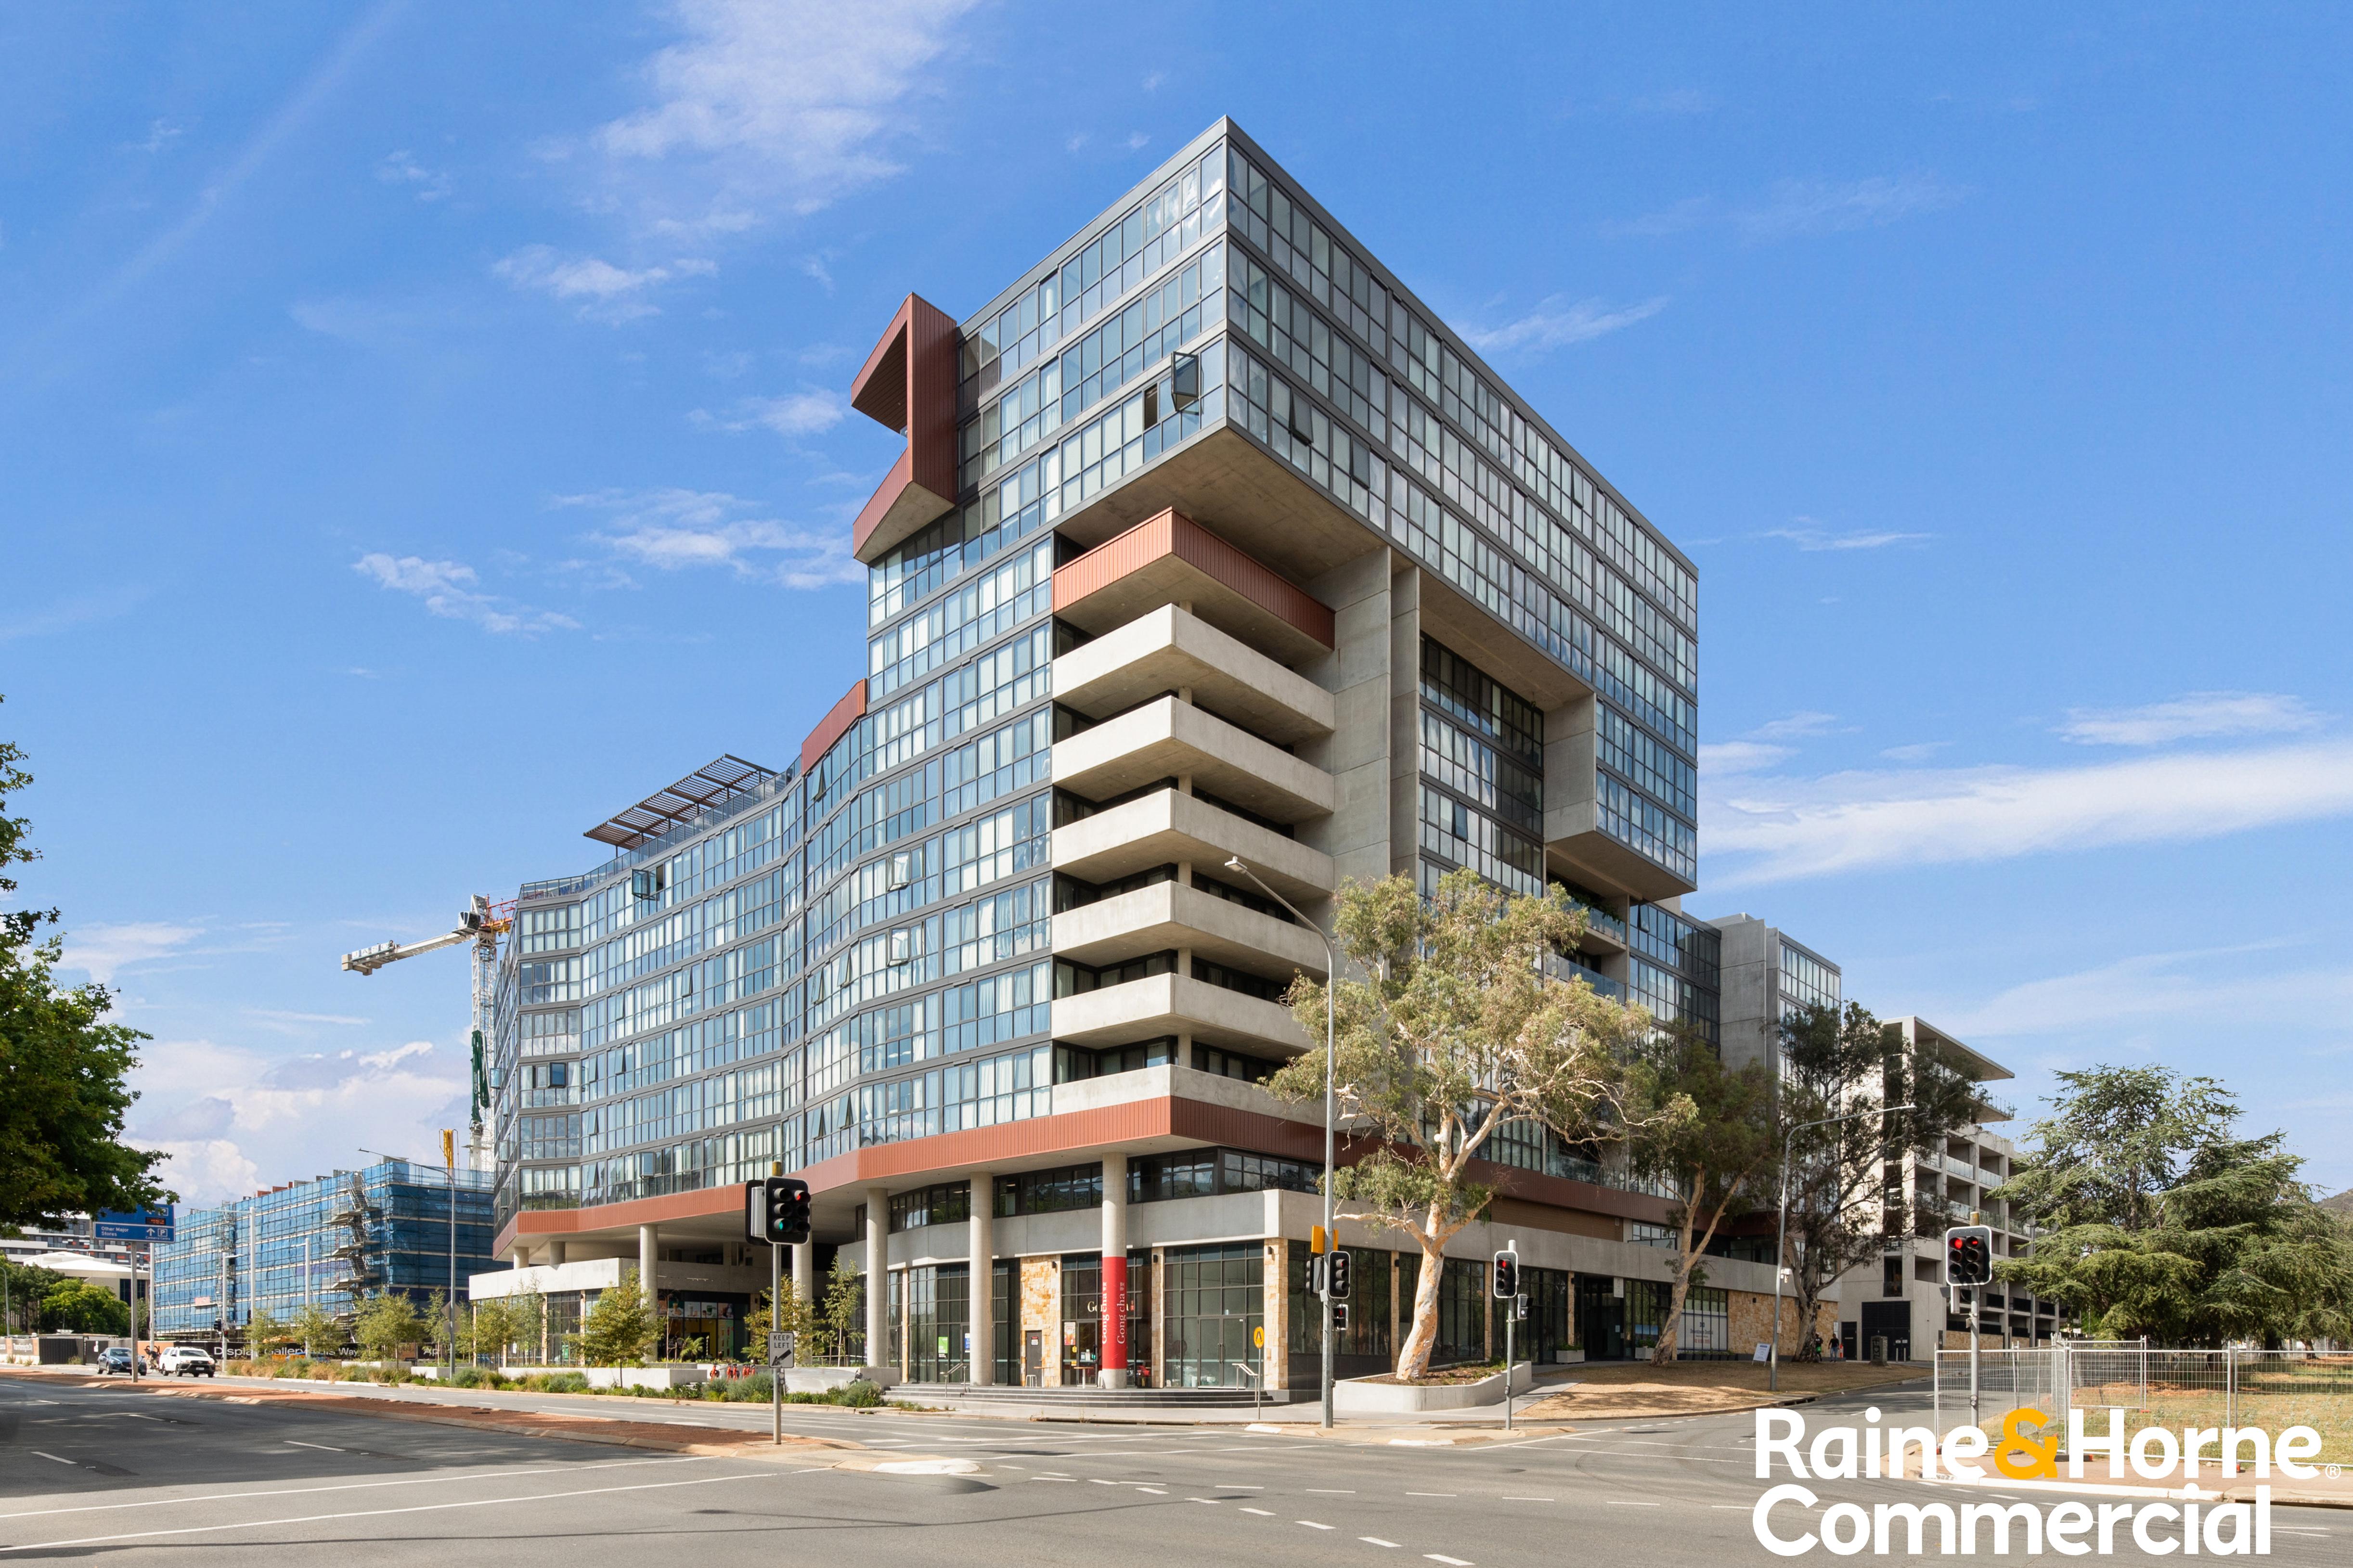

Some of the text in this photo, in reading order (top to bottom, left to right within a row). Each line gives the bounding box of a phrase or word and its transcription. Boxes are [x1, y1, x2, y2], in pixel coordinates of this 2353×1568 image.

[1117, 1293, 1125, 1312] cha
[1117, 1314, 1126, 1344] Gong
[214, 1347, 255, 1357] Dspla
